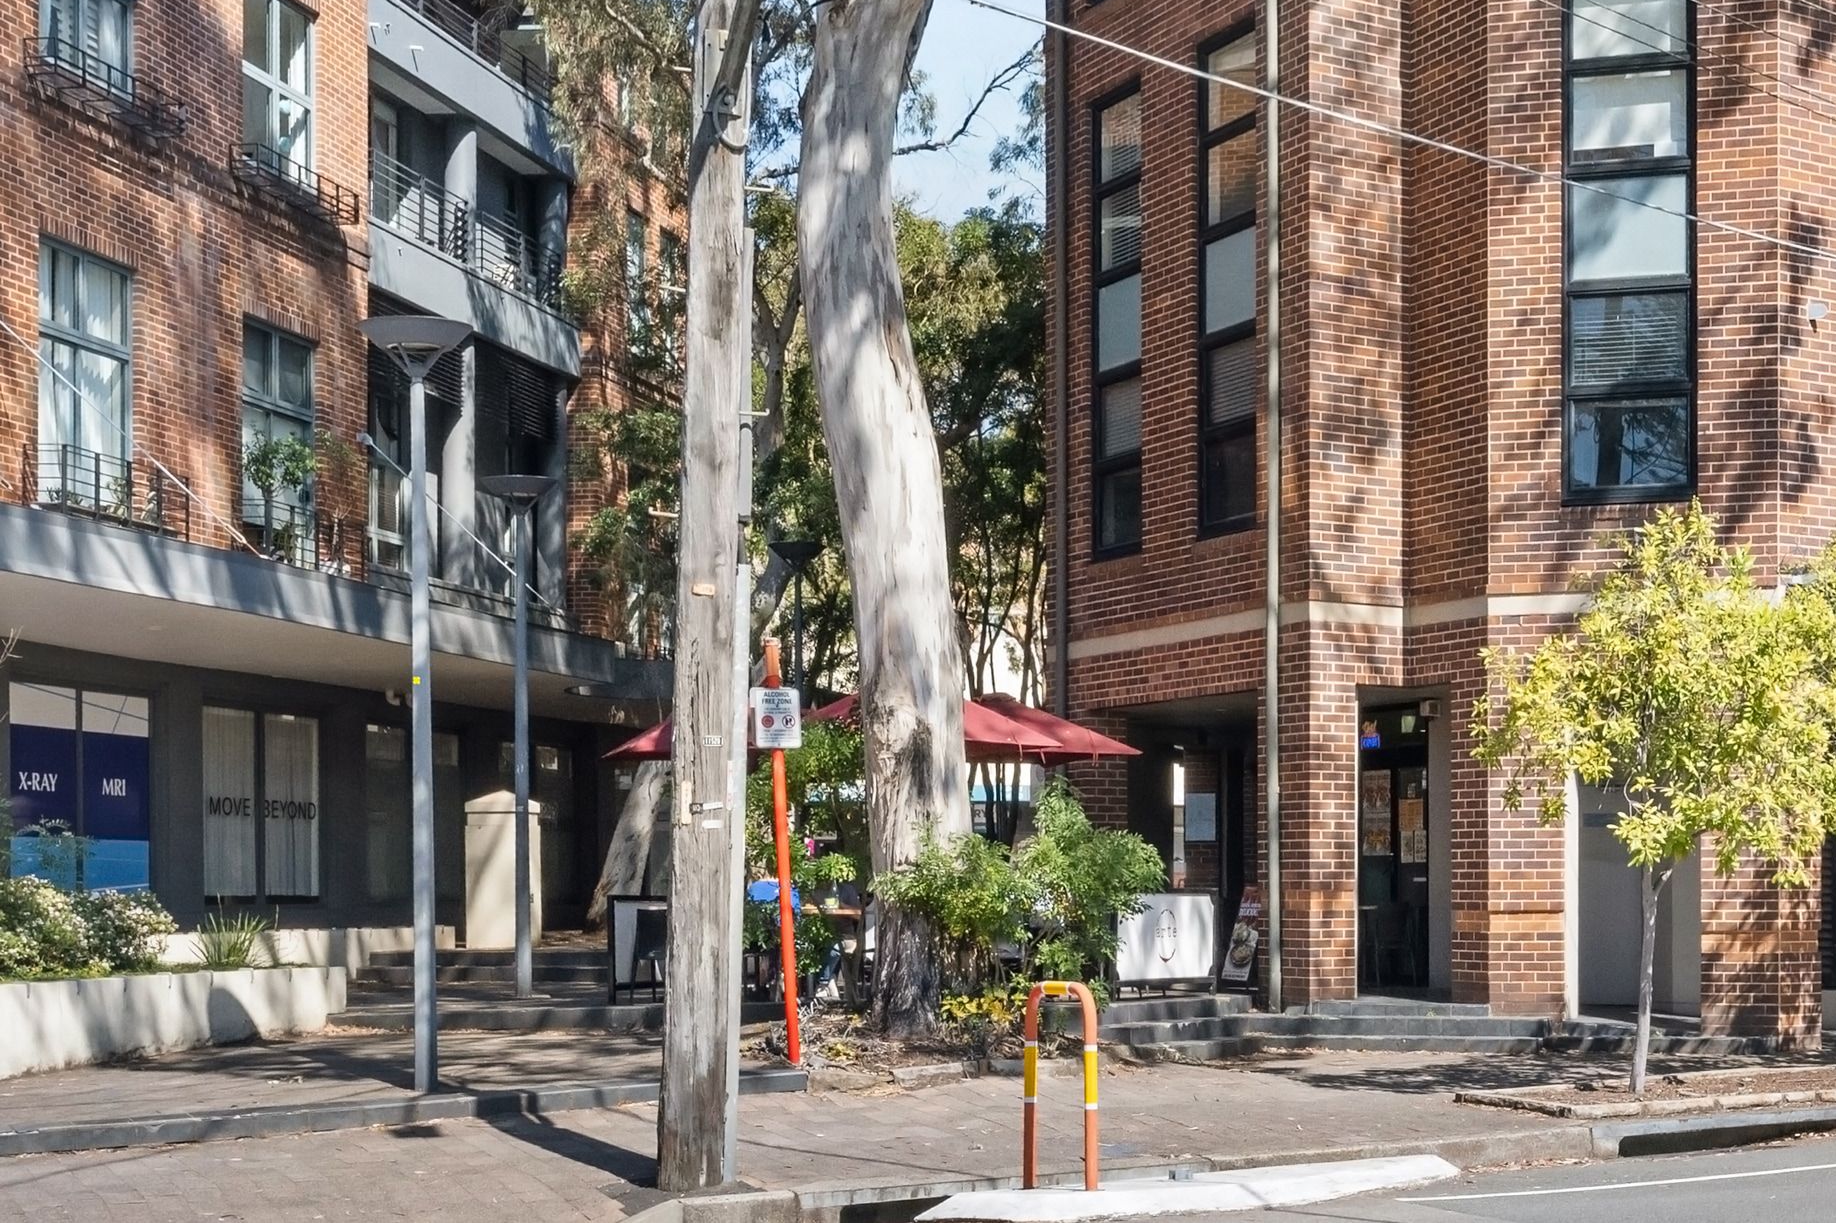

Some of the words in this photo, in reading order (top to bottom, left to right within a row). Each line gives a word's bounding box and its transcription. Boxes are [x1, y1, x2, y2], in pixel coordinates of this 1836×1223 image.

[18, 771, 58, 792] X-RAY
[102, 778, 126, 796] MRI
[209, 796, 251, 817] MOVE
[264, 799, 317, 820] BEYOND
